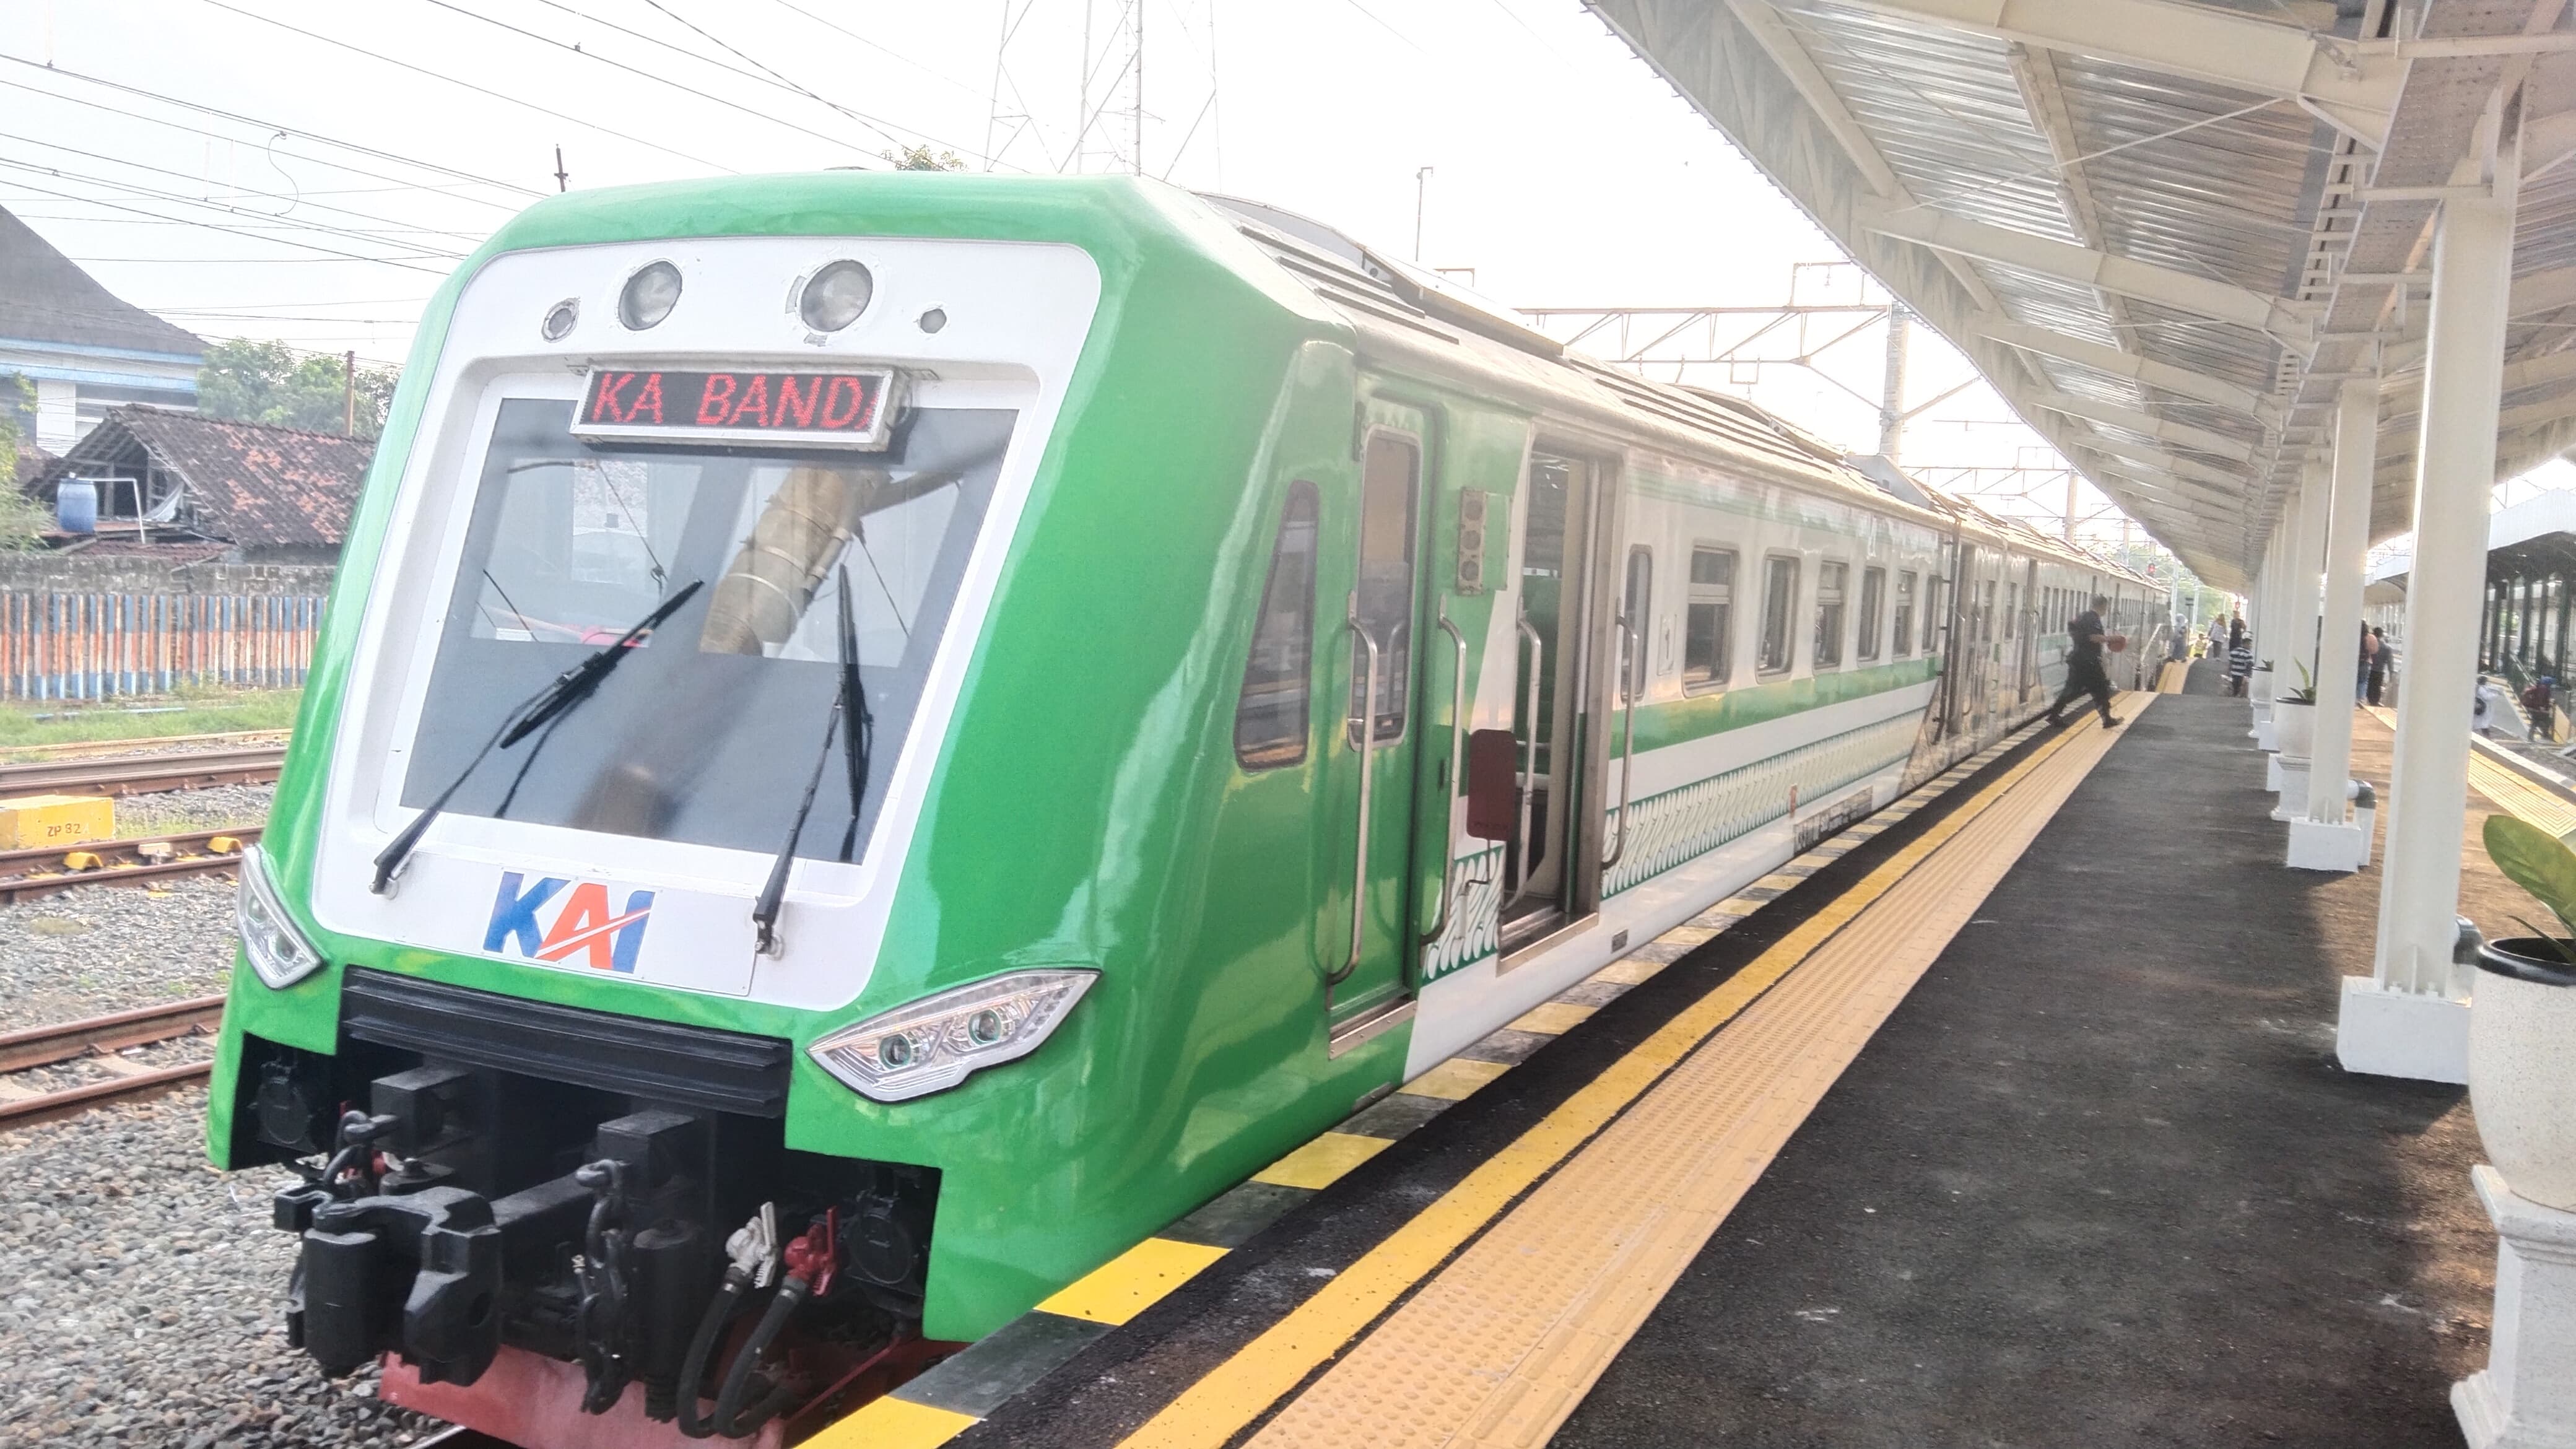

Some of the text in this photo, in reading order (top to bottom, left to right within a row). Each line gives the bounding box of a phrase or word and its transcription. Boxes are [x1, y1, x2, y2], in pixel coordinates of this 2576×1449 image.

[592, 372, 664, 424] KA
[47, 825, 61, 837] ZP
[483, 871, 656, 973] KAI
